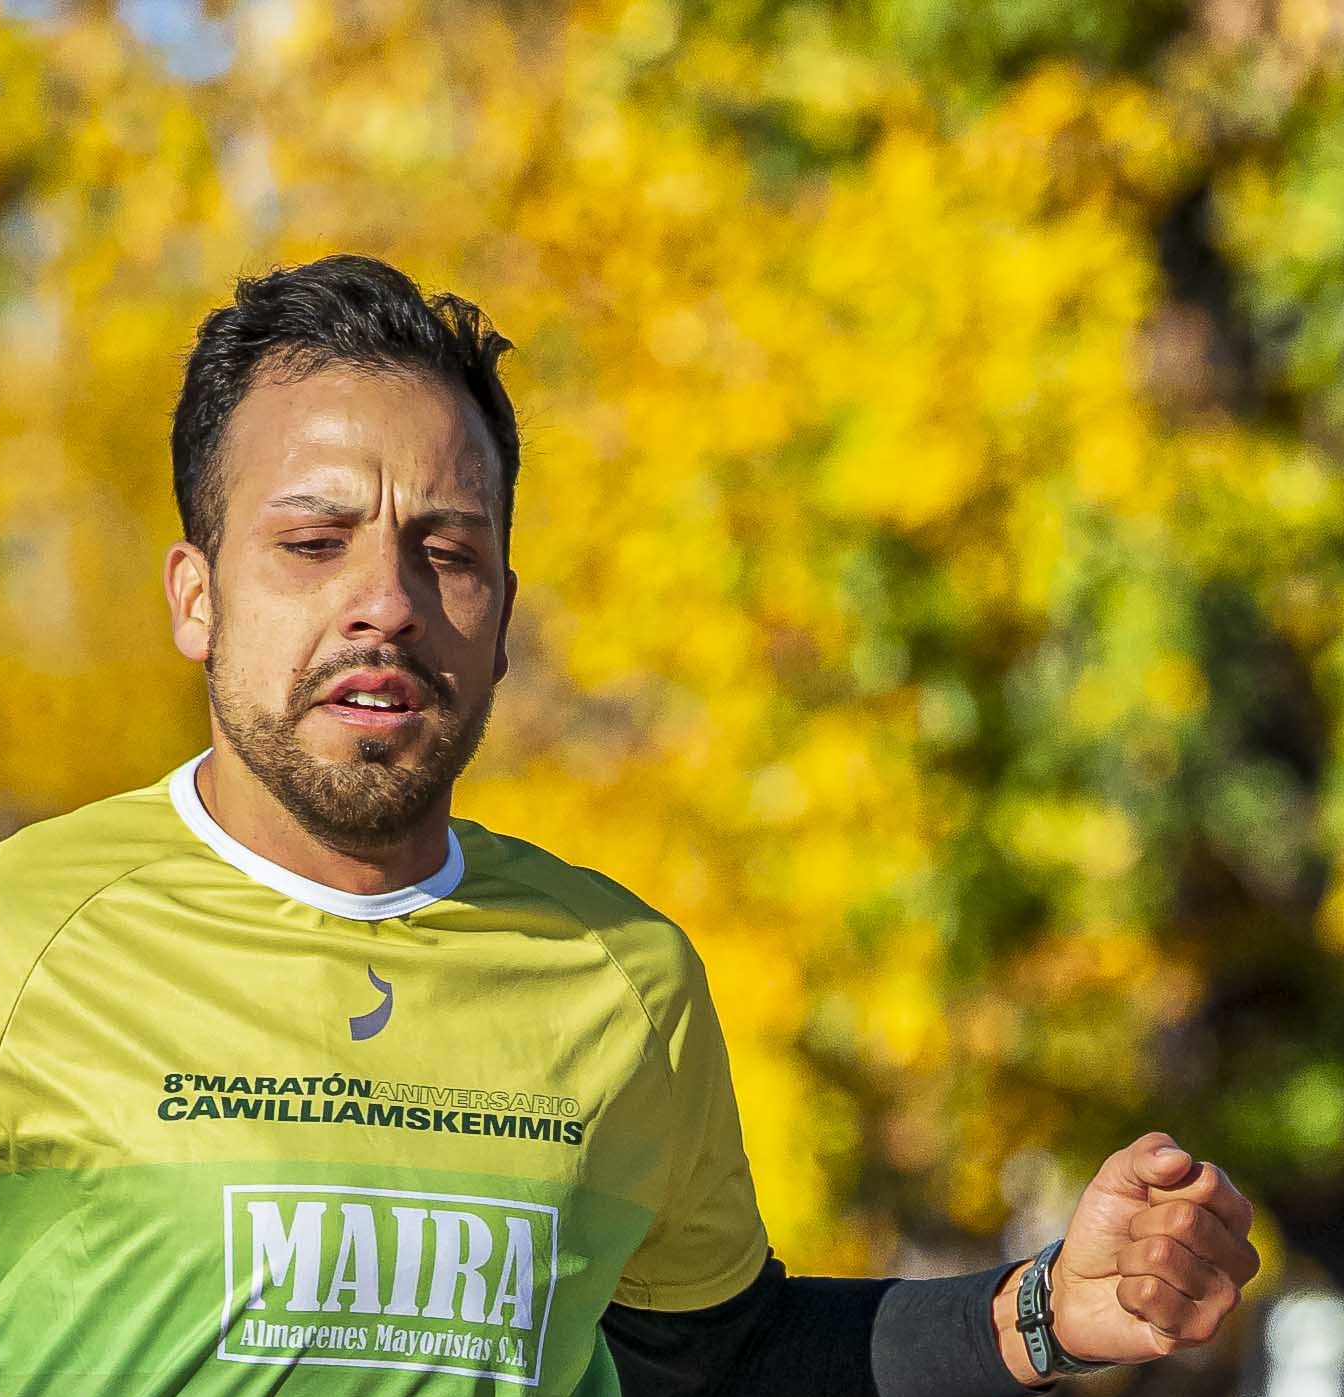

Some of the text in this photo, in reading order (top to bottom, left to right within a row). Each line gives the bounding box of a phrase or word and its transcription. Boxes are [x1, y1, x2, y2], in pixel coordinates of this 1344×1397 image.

[157, 1095, 585, 1146] CAWILLIAMSKEMMIS
[370, 1081, 580, 1117] ANIVERSARIO
[247, 1200, 534, 1330] MAIRA
[240, 1319, 528, 1368] Almacenes Mayoristas S.A.
